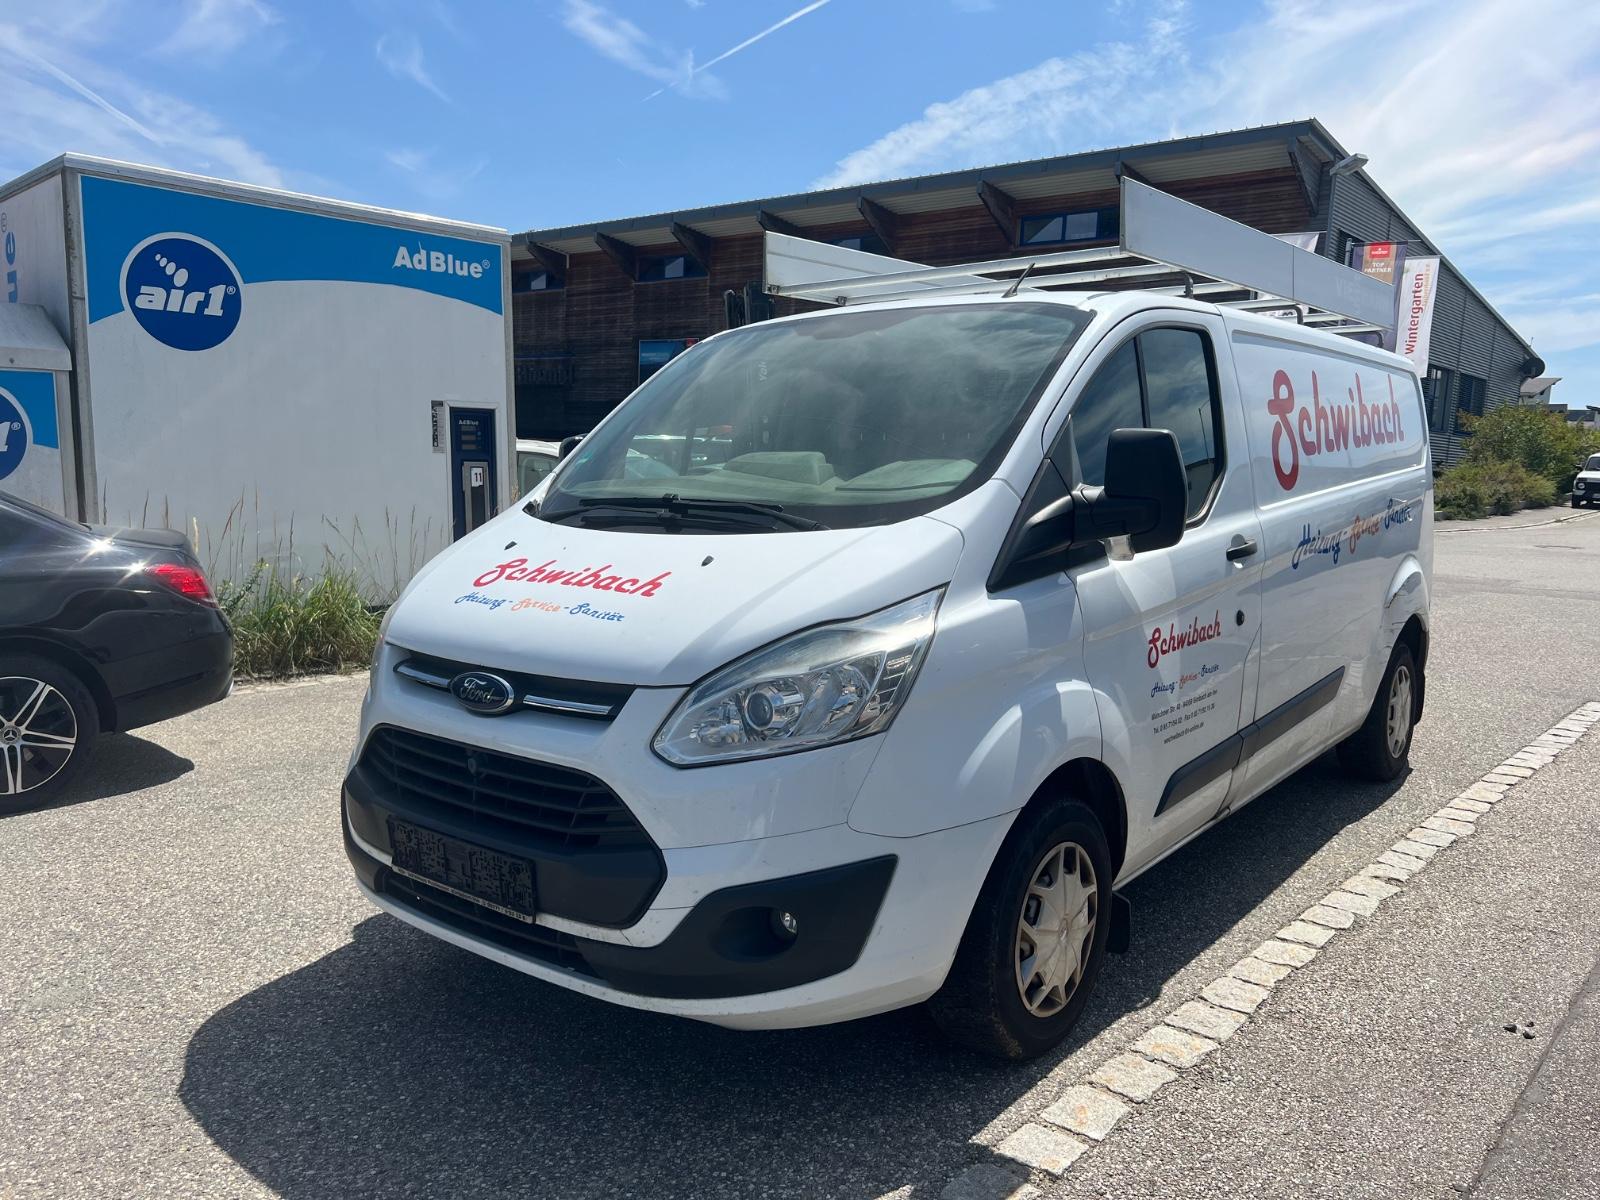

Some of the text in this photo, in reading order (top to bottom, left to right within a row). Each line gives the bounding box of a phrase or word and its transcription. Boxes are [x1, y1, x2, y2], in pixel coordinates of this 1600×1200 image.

[1404, 273, 1424, 355] Wintergarten
[1268, 369, 1404, 491] Schwibach
[474, 472, 482, 482] 11
[473, 558, 672, 597] Schwibach
[455, 591, 505, 610] Heizung
[511, 597, 561, 612] Service
[569, 602, 625, 622] Sanitär
[1148, 609, 1221, 669] Schwibach
[460, 677, 503, 703] Ford
